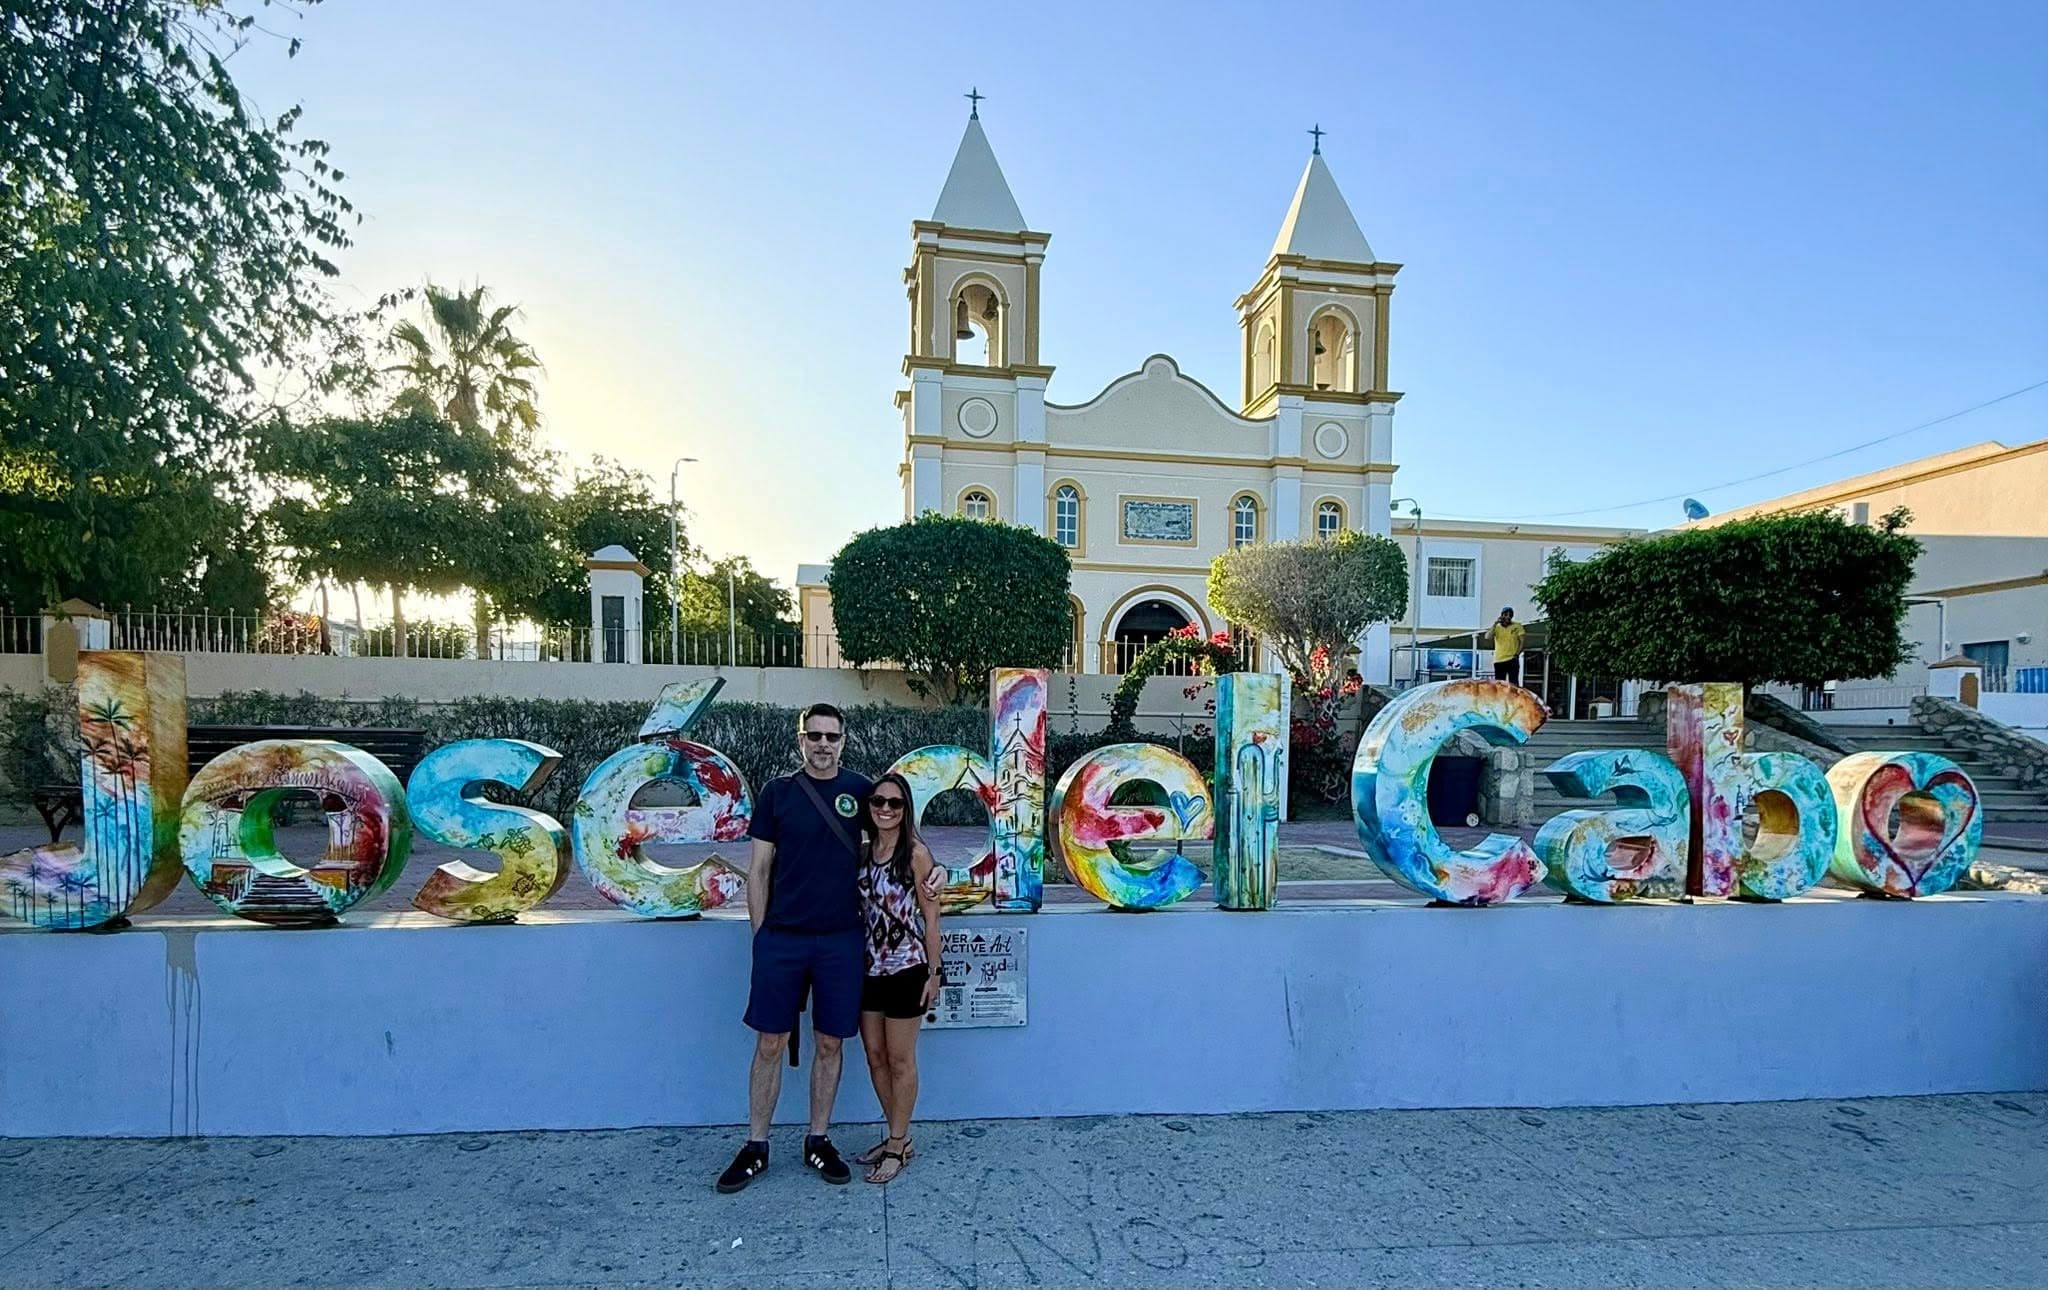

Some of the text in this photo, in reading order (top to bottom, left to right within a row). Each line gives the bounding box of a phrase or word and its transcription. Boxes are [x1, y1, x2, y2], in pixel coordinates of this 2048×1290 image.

[0, 650, 1986, 930] José del Cabo
[940, 934, 968, 943] VER
[989, 934, 1013, 953] Art
